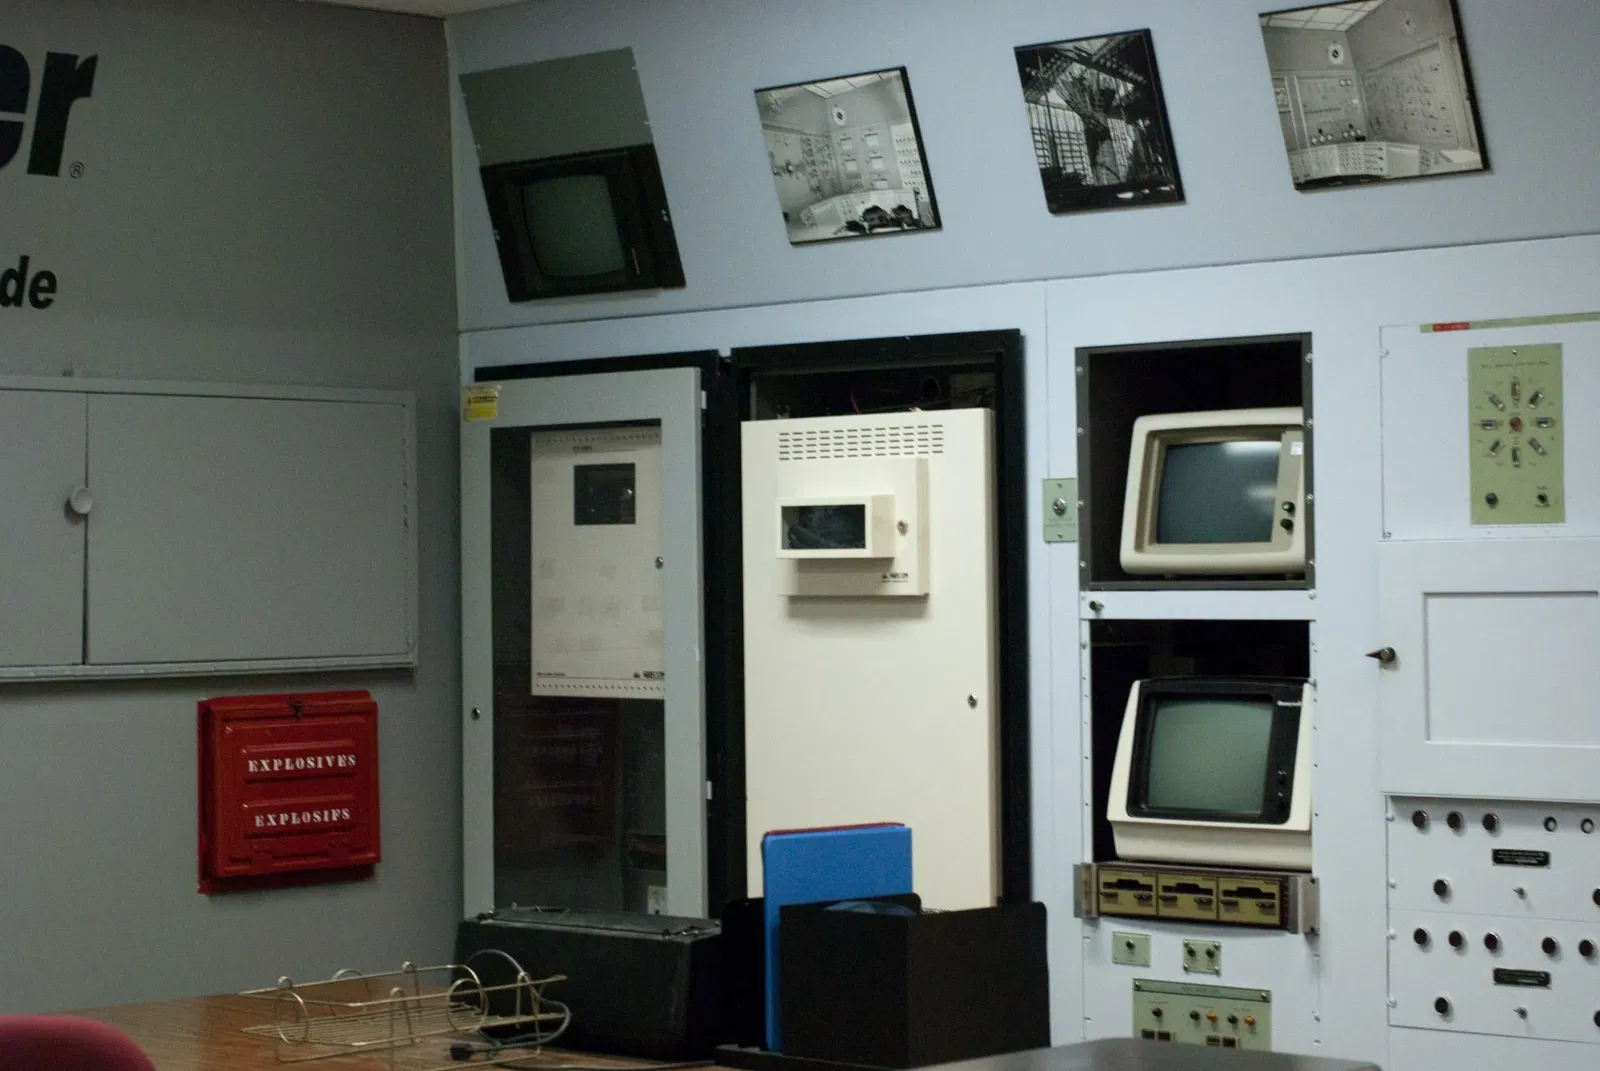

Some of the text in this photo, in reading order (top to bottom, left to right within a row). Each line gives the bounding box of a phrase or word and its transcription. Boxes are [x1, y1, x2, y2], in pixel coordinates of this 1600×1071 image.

[0, 254, 58, 309] de
[248, 754, 357, 773] EXPLOSIVES
[254, 808, 351, 828] EXPLOSIFS
